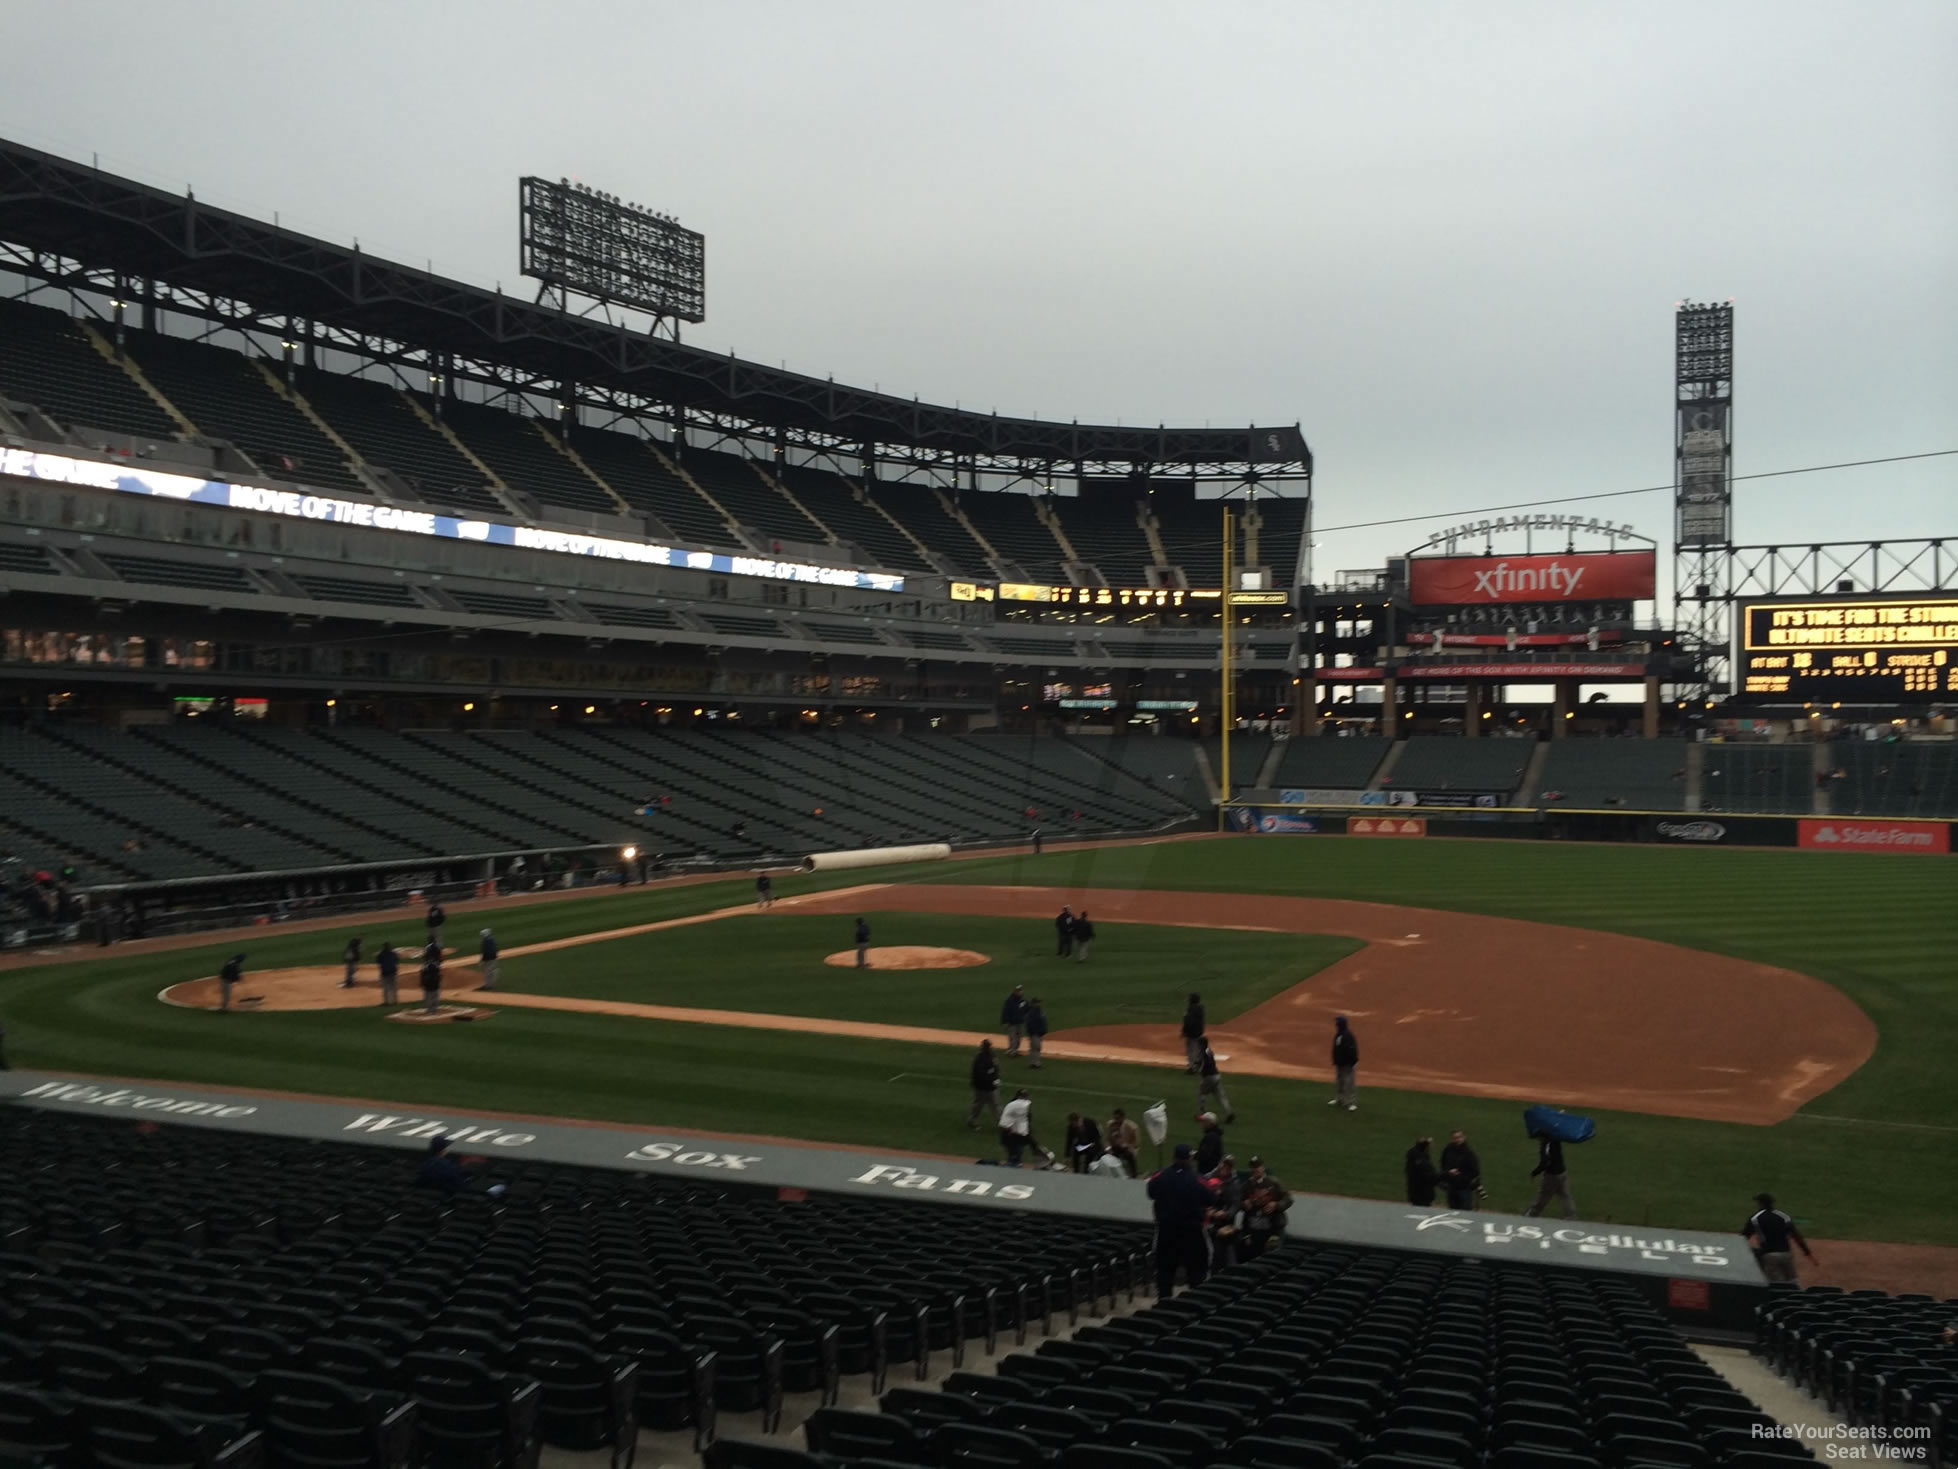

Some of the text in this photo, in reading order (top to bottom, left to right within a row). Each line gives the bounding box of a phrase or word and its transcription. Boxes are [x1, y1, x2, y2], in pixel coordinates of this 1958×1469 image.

[229, 484, 436, 534] MOVE OF THE GAME
[1428, 514, 1635, 552] FUNDAMENTALS
[731, 556, 775, 577] MOVE
[1473, 562, 1586, 598] xfinity
[1773, 611, 1805, 626] IT'S
[1804, 609, 1845, 625] TIME
[1845, 609, 1876, 625] FOR
[1877, 607, 1910, 624] THE
[1769, 628, 1845, 644] ULTIMATE
[1844, 627, 1897, 643] SEATS
[1766, 657, 1789, 668] BAT
[1832, 651, 1877, 668] BALL 0
[1887, 650, 1947, 667] STRIKE 0
[20, 1081, 257, 1118] Welcome
[343, 1113, 536, 1147] White
[623, 1142, 763, 1170] Sox
[848, 1163, 1036, 1200] Fans
